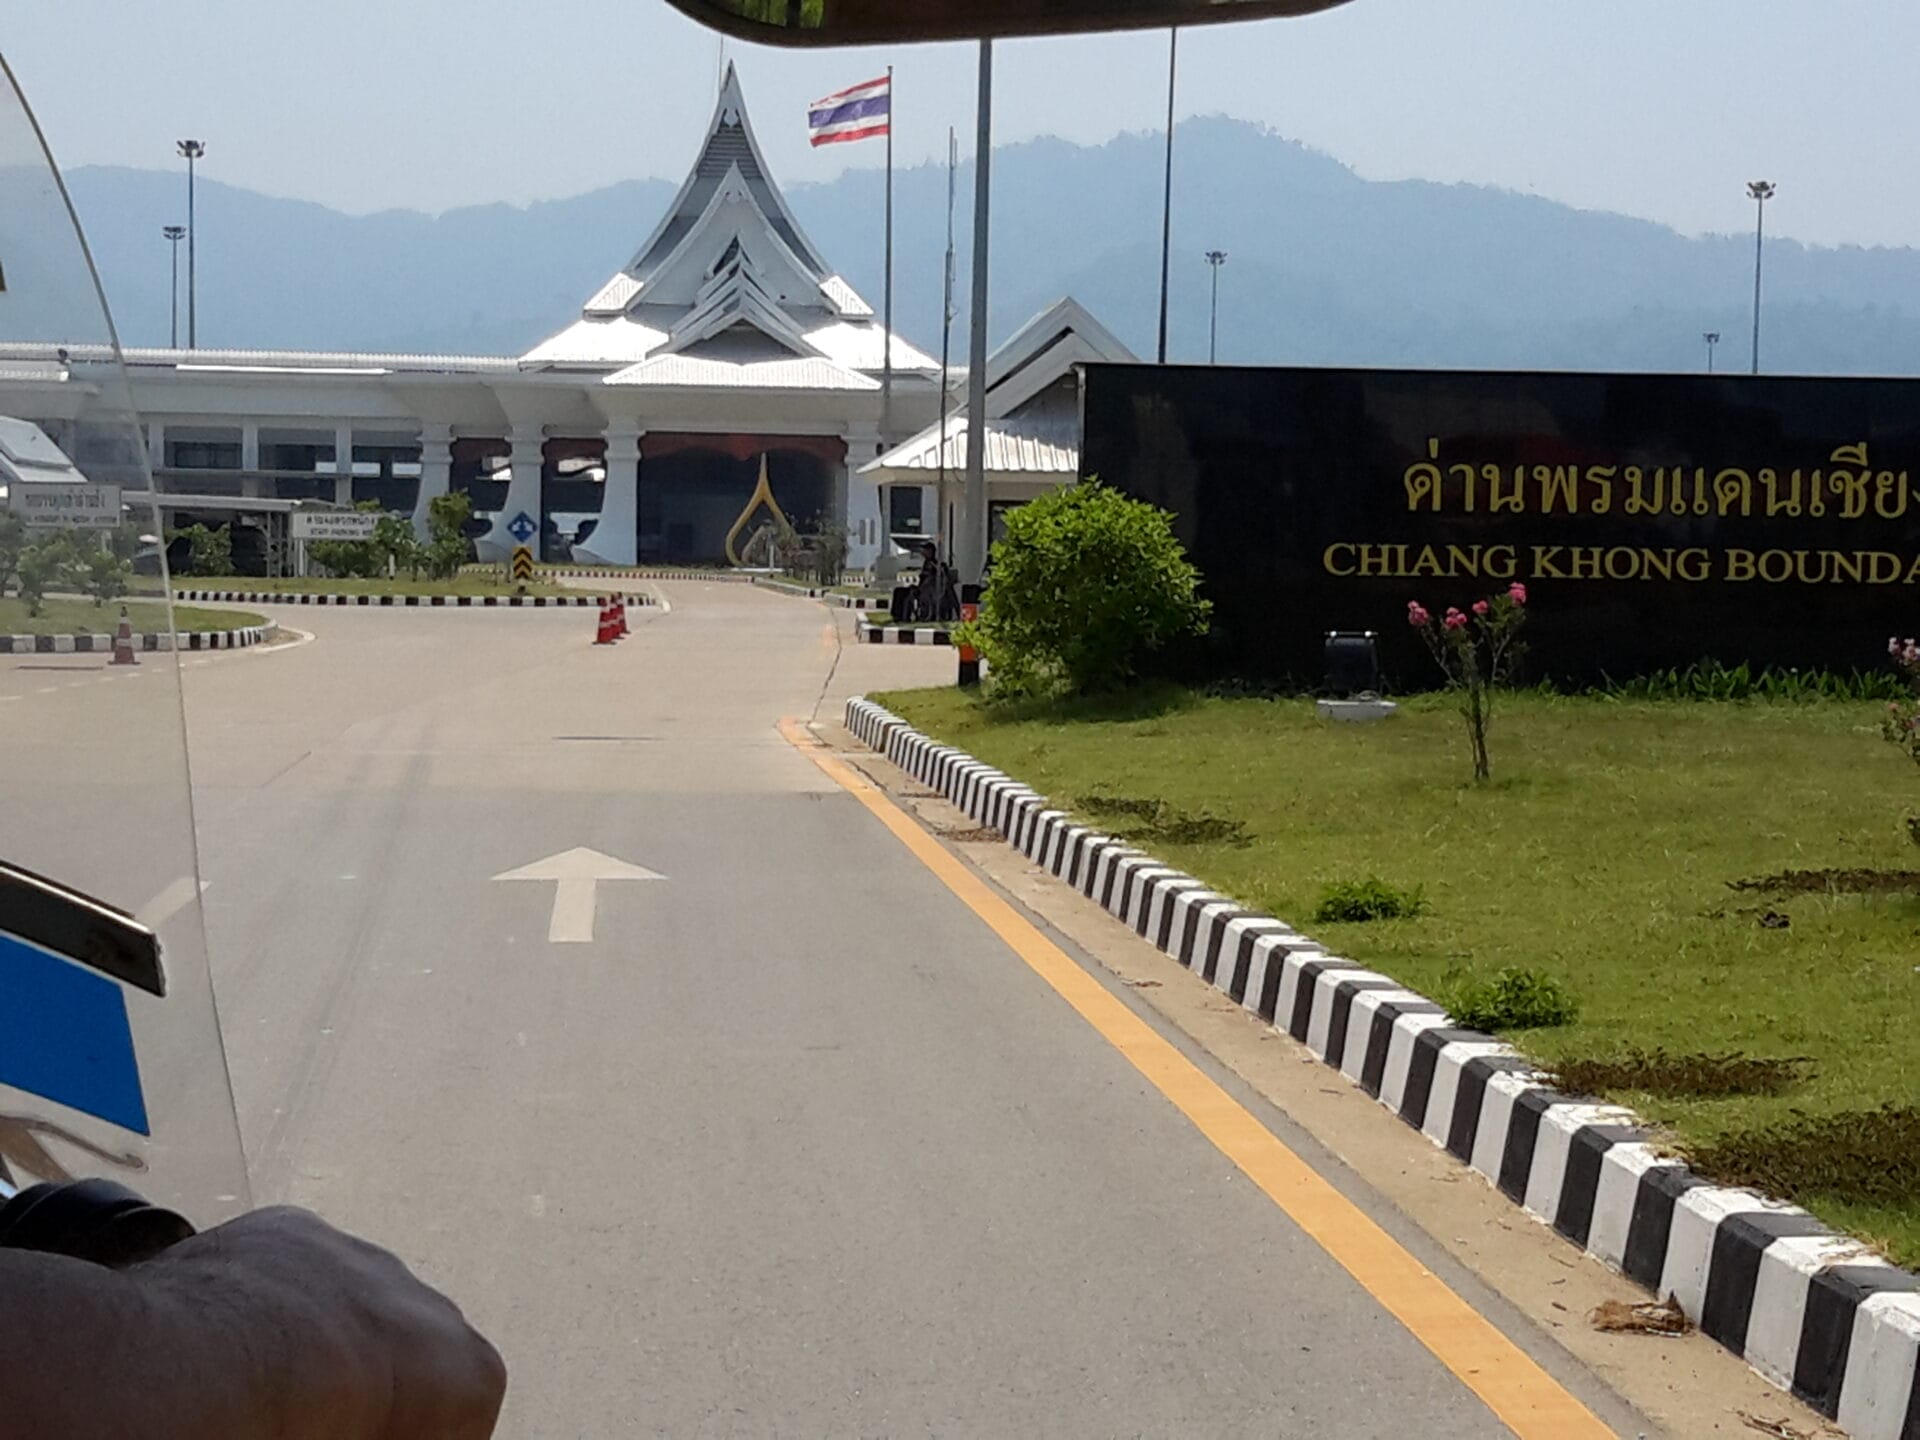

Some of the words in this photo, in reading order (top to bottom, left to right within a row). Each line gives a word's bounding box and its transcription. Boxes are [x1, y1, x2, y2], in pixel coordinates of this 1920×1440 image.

[1404, 438, 1920, 519] ด่านพรมแดนเชีย
[1322, 543, 1517, 578] CHIANG
[1530, 546, 1713, 580] KHONG
